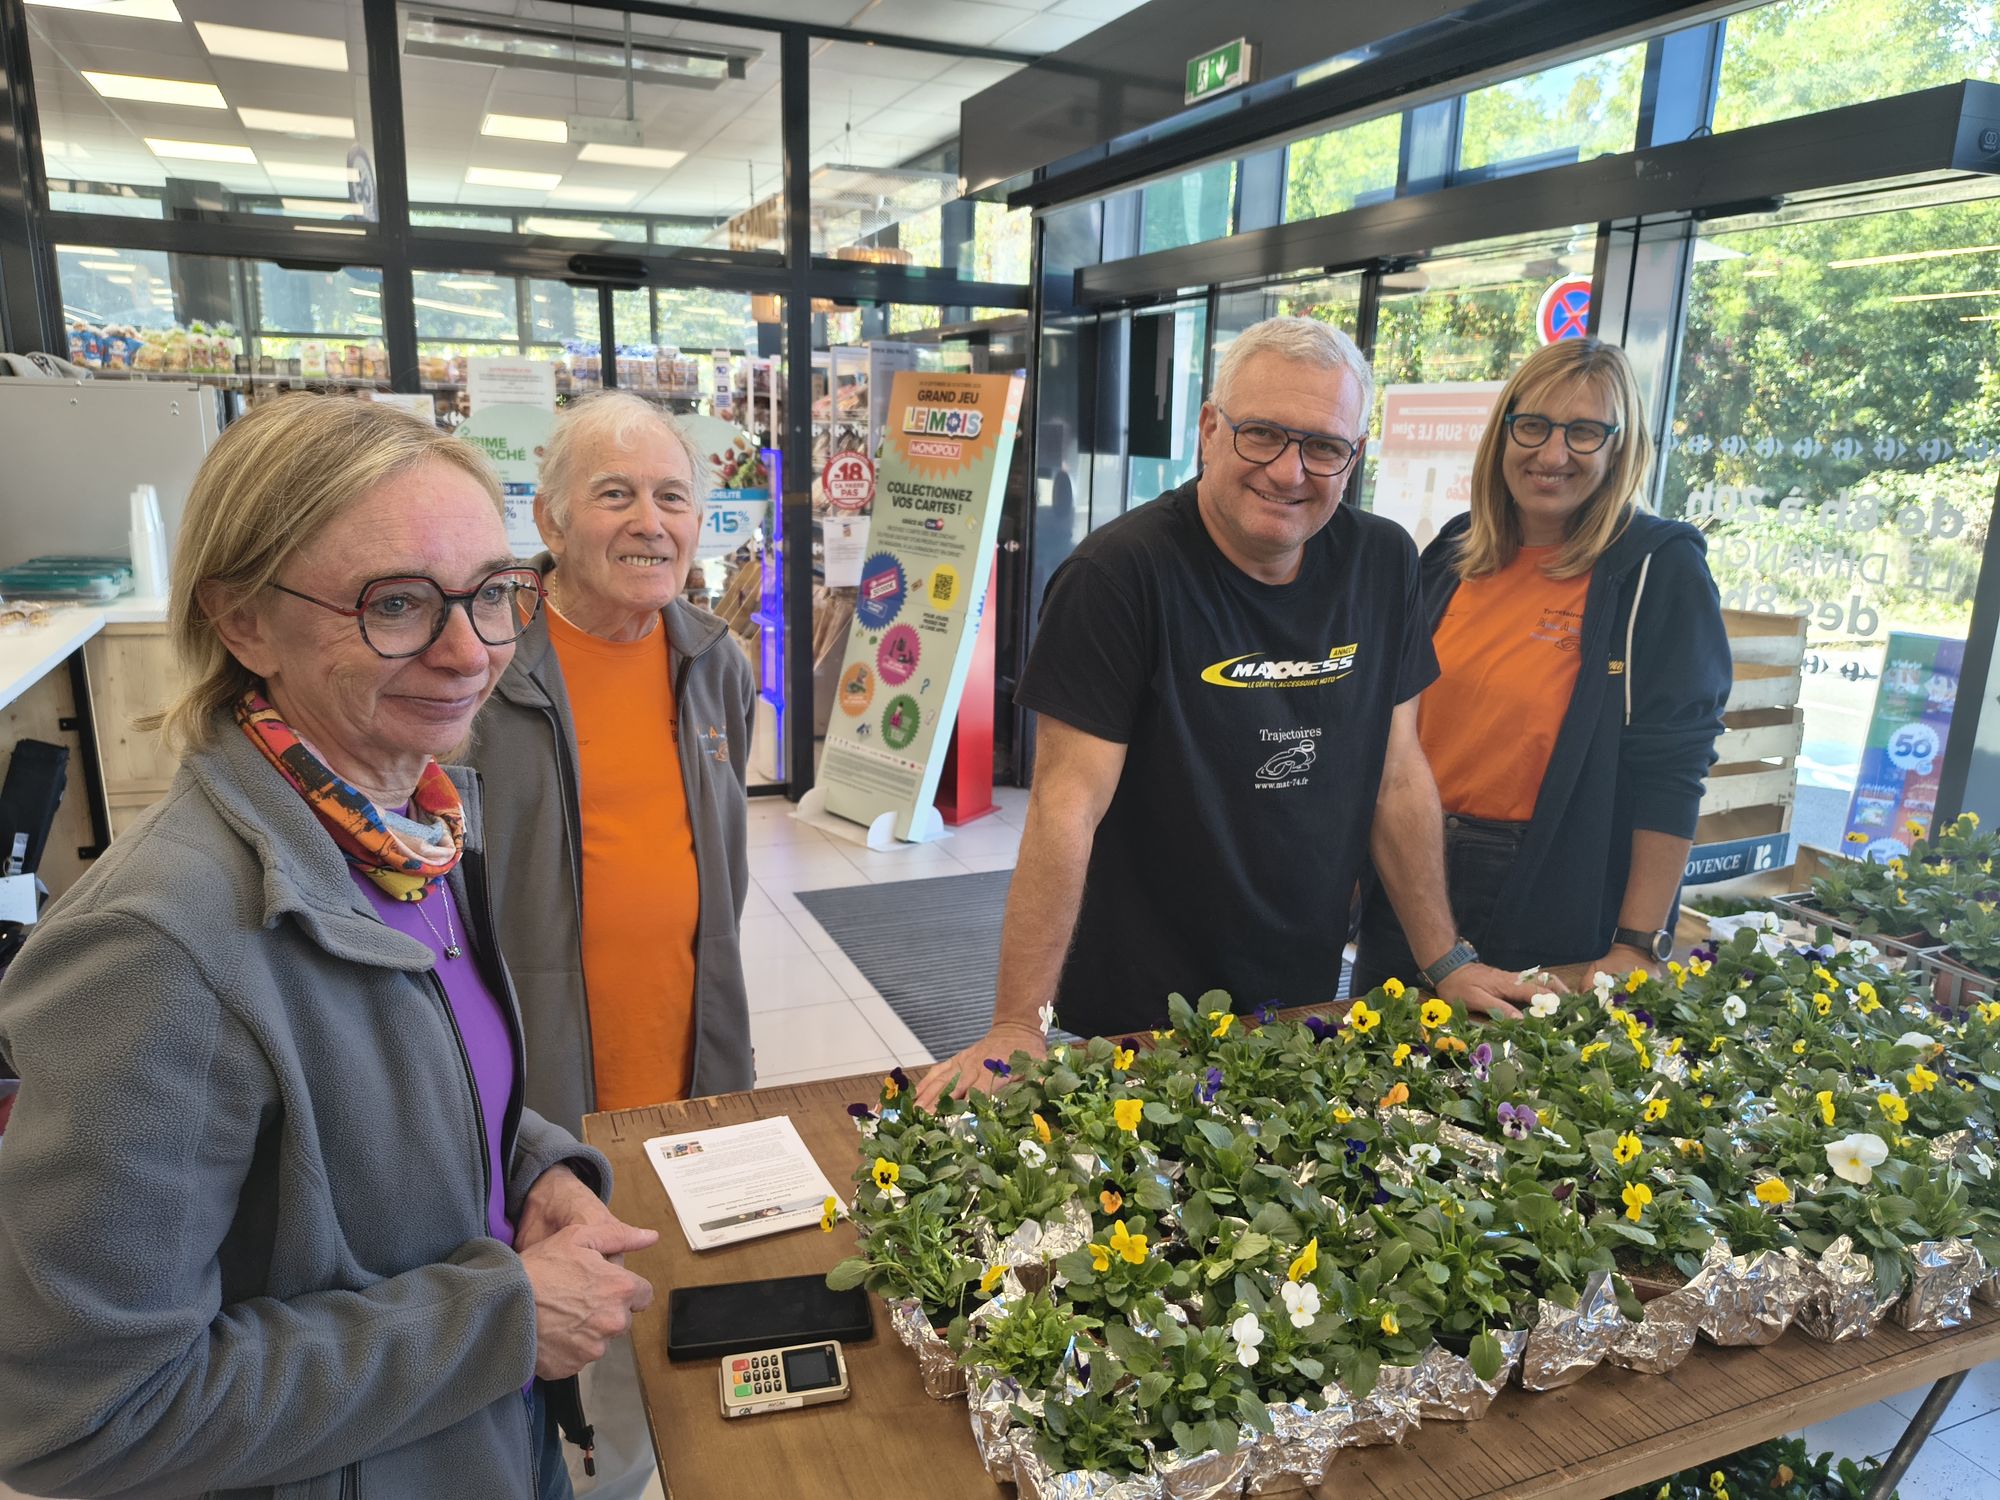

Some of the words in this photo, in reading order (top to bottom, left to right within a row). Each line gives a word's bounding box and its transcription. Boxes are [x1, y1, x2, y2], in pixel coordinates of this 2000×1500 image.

[917, 389, 956, 403] GRAND
[957, 392, 979, 405] JEU
[487, 447, 526, 461] RCHÉ
[910, 442, 960, 456] MONOPOLY
[887, 481, 973, 502] COLLECTIONNEZ
[892, 496, 913, 509] VOS
[915, 499, 956, 514] CARTES
[1230, 655, 1354, 680] MAXXESS
[1259, 726, 1322, 743] Trajectoires
[1254, 776, 1309, 790] www.mat-74.fr
[1684, 853, 1742, 877] OVENCE
